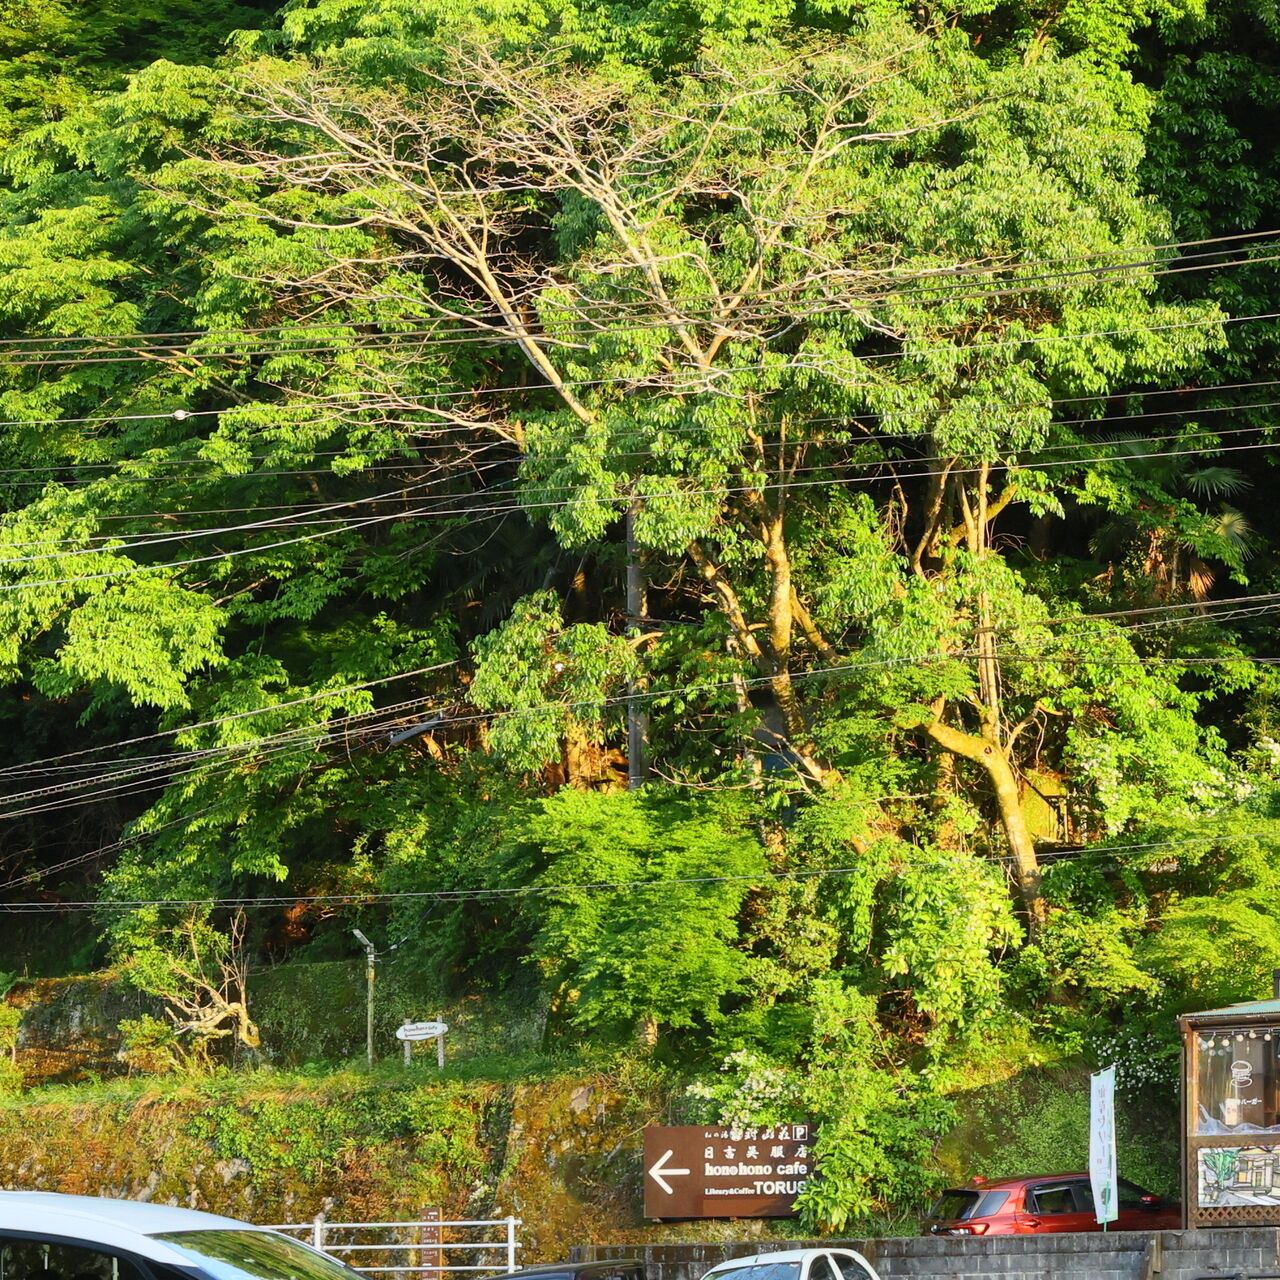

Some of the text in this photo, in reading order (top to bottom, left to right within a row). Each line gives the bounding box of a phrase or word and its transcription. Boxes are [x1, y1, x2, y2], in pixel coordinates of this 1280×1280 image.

[795, 1127, 805, 1139] P
[776, 1162, 807, 1175] cafe
[753, 1181, 807, 1195] TORUS
